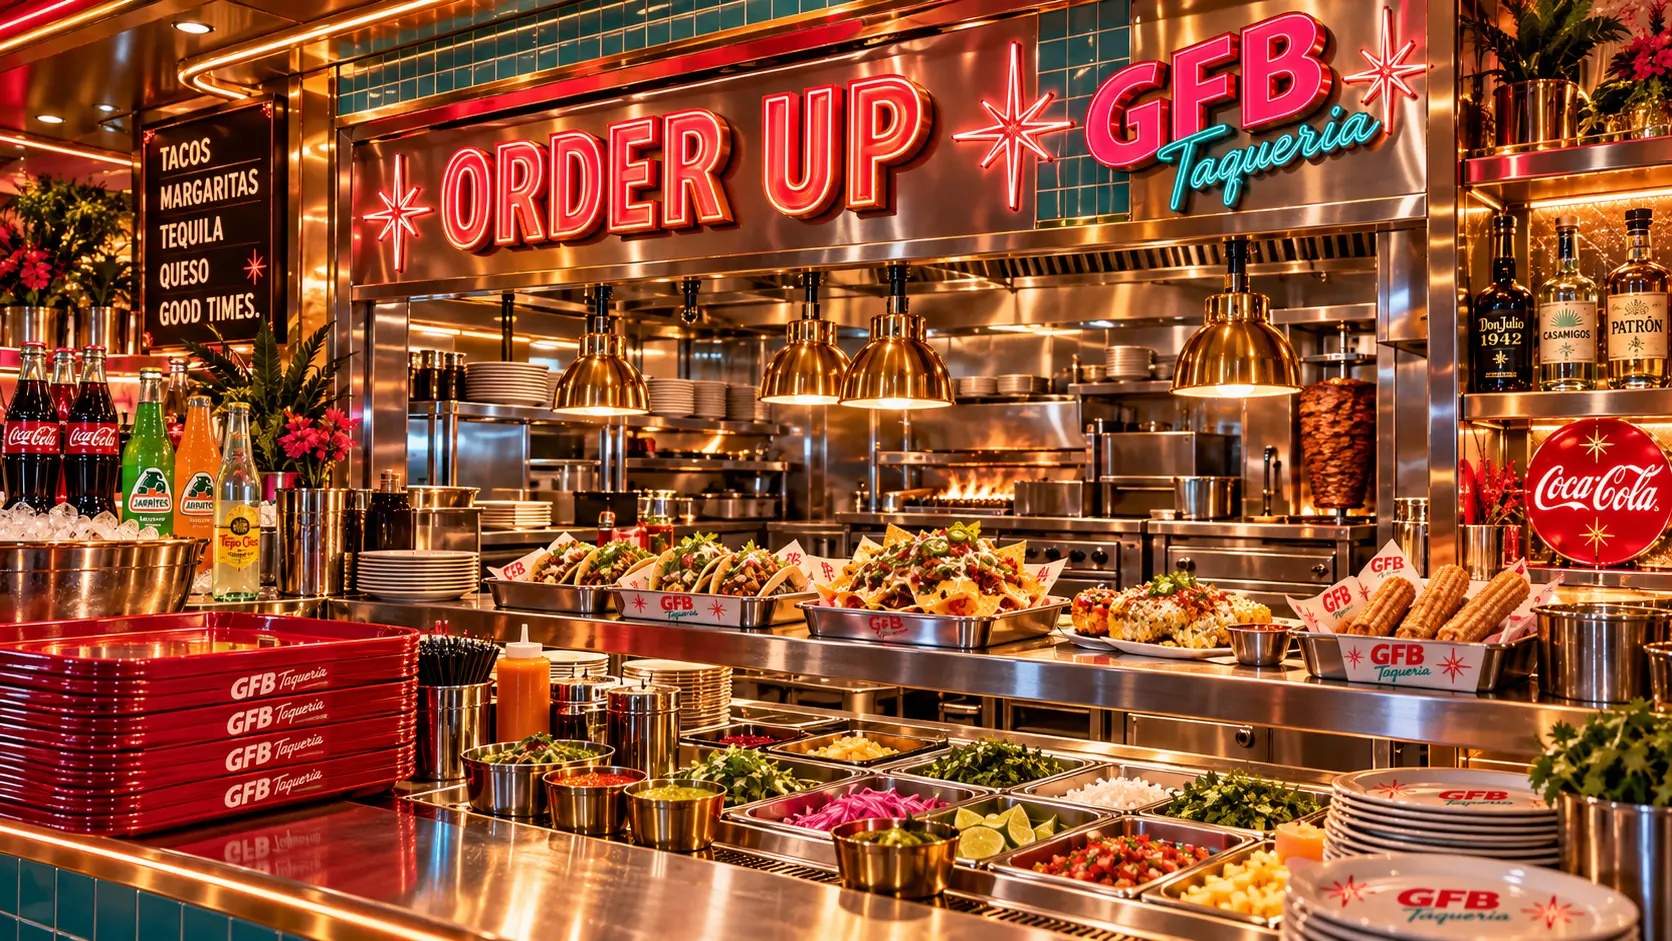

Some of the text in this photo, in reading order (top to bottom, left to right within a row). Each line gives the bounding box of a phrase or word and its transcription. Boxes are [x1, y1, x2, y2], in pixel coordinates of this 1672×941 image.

[1085, 11, 1332, 171] GFB
[159, 137, 211, 172] TACOS
[440, 74, 932, 252] ORDER UP
[1157, 104, 1383, 212] Taqueria
[159, 168, 259, 211] MARGARITAS
[159, 215, 224, 249] TEQUILA
[159, 258, 209, 290] QUESO
[159, 292, 261, 326] GOOD TIMES.
[1479, 316, 1524, 333] Don Julio
[1611, 315, 1663, 335] PATRÓN
[1481, 332, 1522, 347] 1942
[1543, 329, 1591, 341] CASAMIGOS
[1534, 464, 1664, 511] Coca-Cola
[1371, 556, 1404, 573] GFB
[660, 595, 694, 611] GFB
[1322, 585, 1352, 613] GFB
[1370, 643, 1425, 665] GFB
[230, 666, 327, 700] GFB Taqueria
[1373, 665, 1432, 683] Taqueria
[227, 698, 325, 735] GFB Taqueria
[225, 733, 324, 772] GFB Taqueria
[224, 768, 323, 808] GFB Taqueria
[1438, 790, 1509, 800] GFB
[1397, 888, 1500, 910] GFB
[1401, 907, 1510, 925] Taqueria
